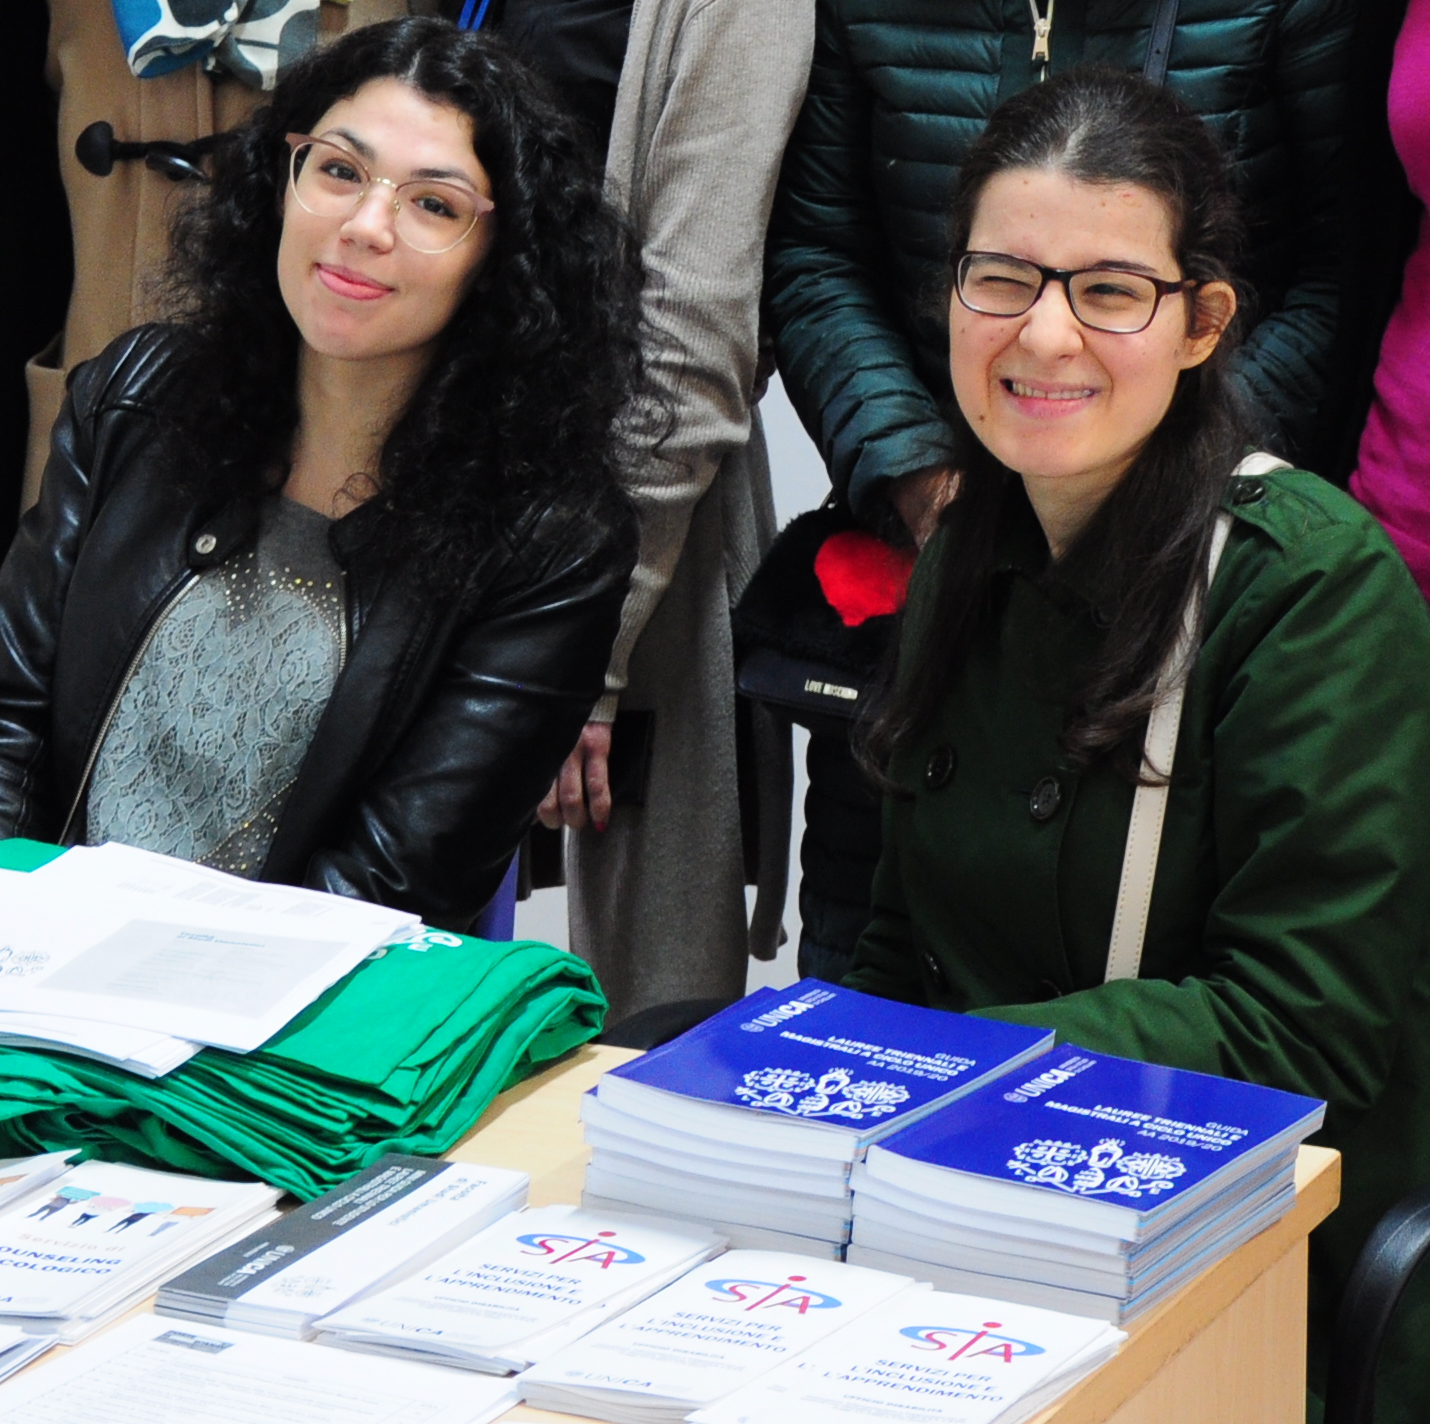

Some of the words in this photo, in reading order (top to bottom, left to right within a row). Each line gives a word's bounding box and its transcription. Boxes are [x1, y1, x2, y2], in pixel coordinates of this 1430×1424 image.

[752, 1000, 815, 1028] UNICA
[779, 1031, 863, 1056] MAGISTRALI
[873, 1053, 915, 1067] CICLO
[915, 1062, 959, 1076] UNICO
[827, 1035, 883, 1053] LAUREE
[884, 1047, 957, 1069] TRIENNALI
[935, 1052, 976, 1067] GUIDA
[1015, 1068, 1075, 1097] UNICA
[1044, 1100, 1131, 1126] MAGISTRALI
[1142, 1122, 1186, 1136] CICLO
[1186, 1131, 1233, 1146] UNICO
[1093, 1104, 1152, 1122] LAUREE
[1152, 1116, 1228, 1138] TRIENNALI
[1206, 1122, 1249, 1136] GUIDA
[453, 1269, 565, 1292] L'INCLUSIONE
[479, 1263, 544, 1279] SERVIZI
[547, 1273, 582, 1285] PER
[424, 1275, 582, 1306] L'APPRENDIMENTO
[647, 1317, 765, 1341] L'INCLUSIONE
[672, 1311, 742, 1327] SERVIZI
[745, 1321, 783, 1333] PER
[619, 1322, 787, 1353] L'APPRENDIMENTO
[851, 1365, 981, 1391] L'INCLUSIONE
[877, 1359, 950, 1377] SERVIZI
[952, 1371, 992, 1383] PER
[823, 1371, 1003, 1402] L'APPRENDIMENTO
